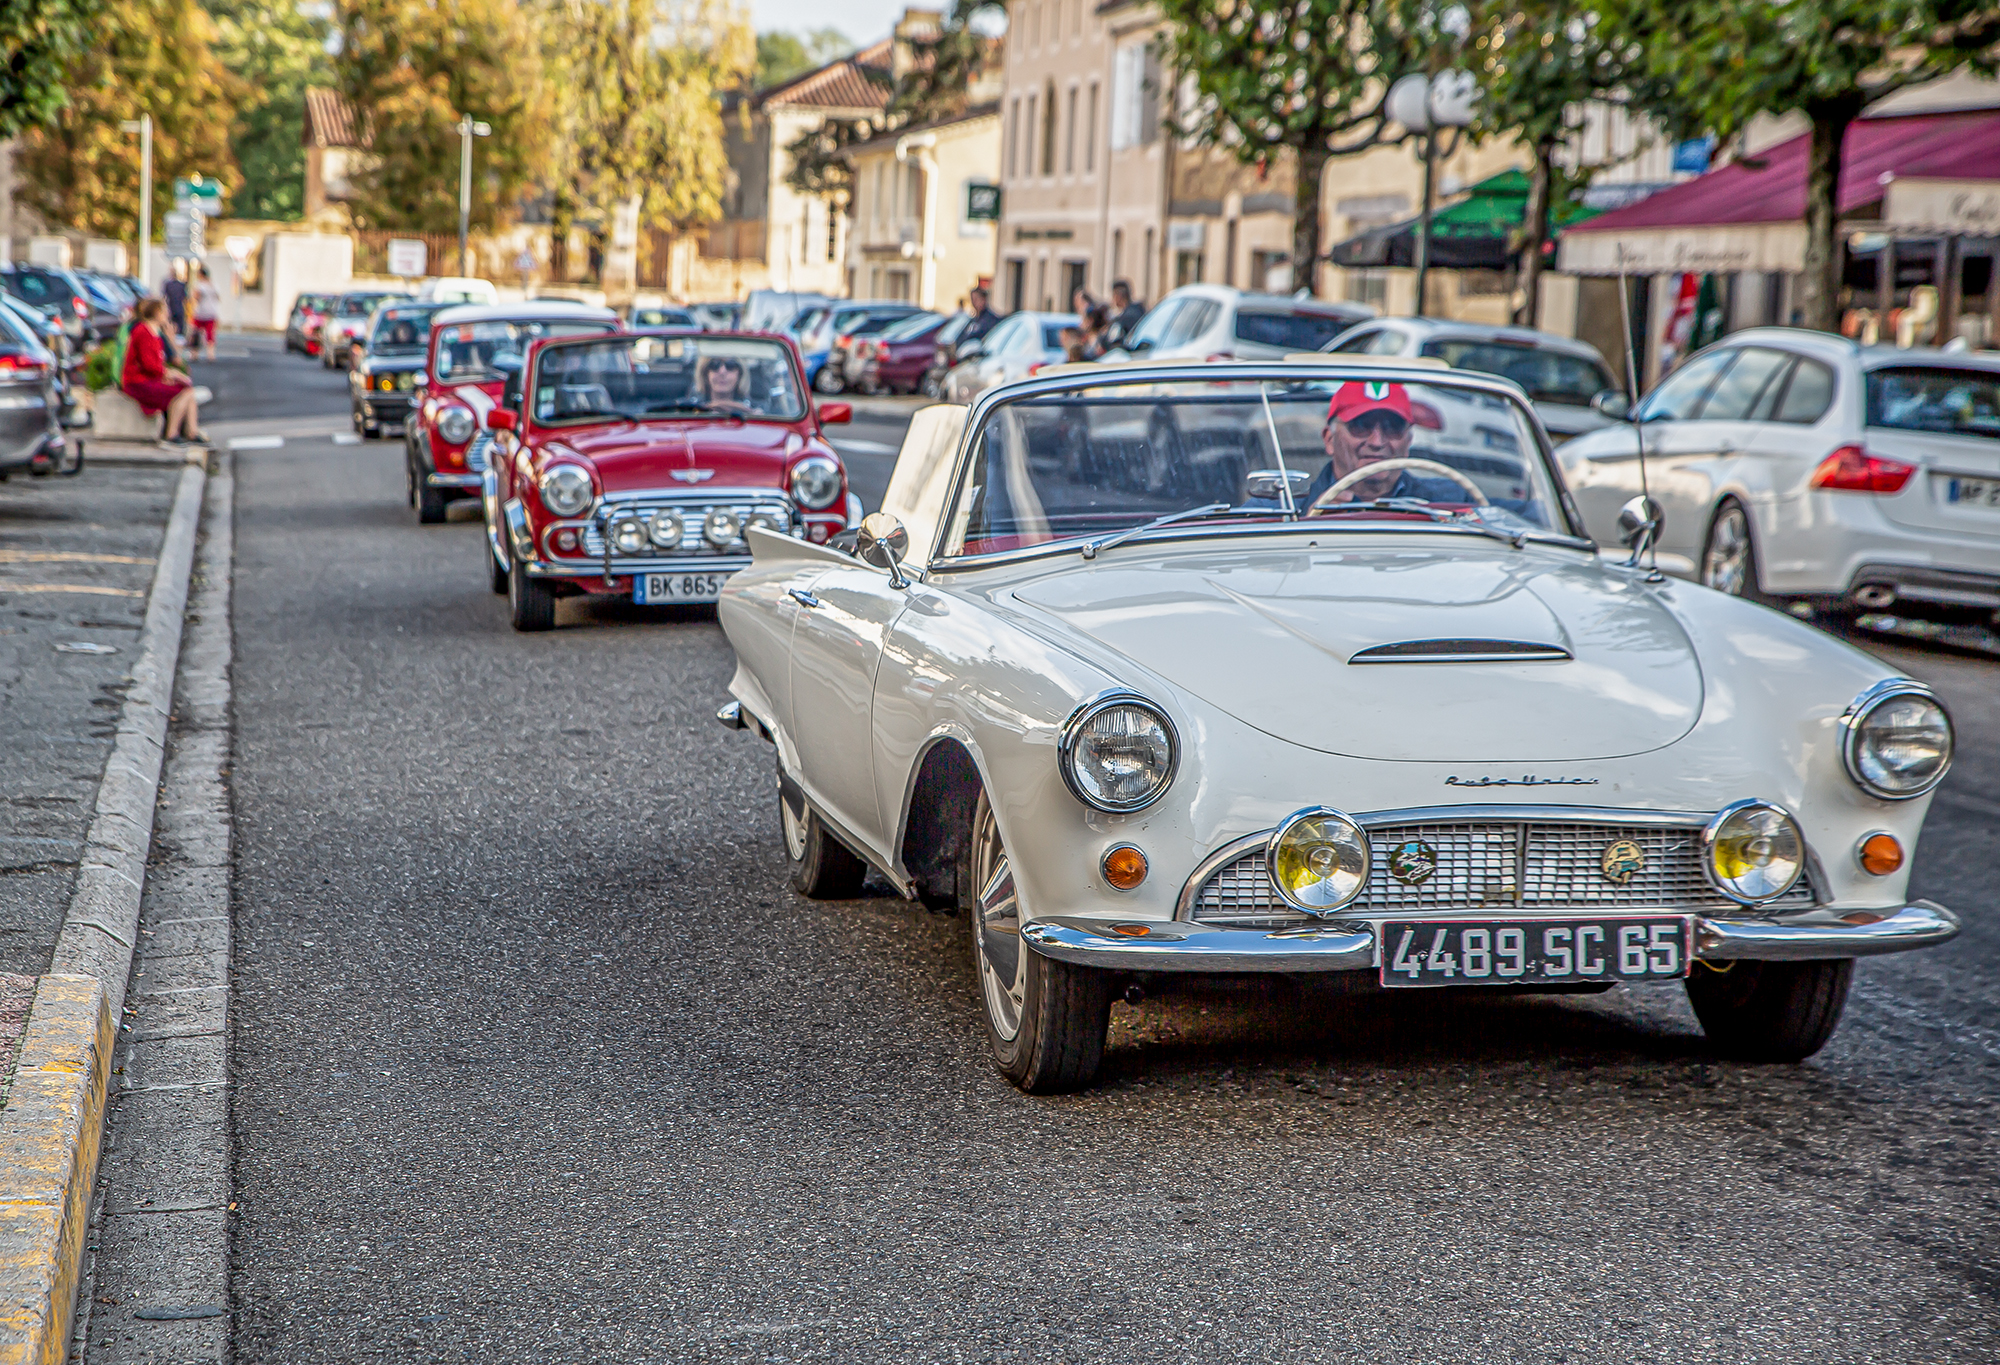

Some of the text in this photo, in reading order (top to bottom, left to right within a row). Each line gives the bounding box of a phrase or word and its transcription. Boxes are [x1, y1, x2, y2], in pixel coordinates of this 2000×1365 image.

[1393, 925, 1679, 979] 4489 SC 65
